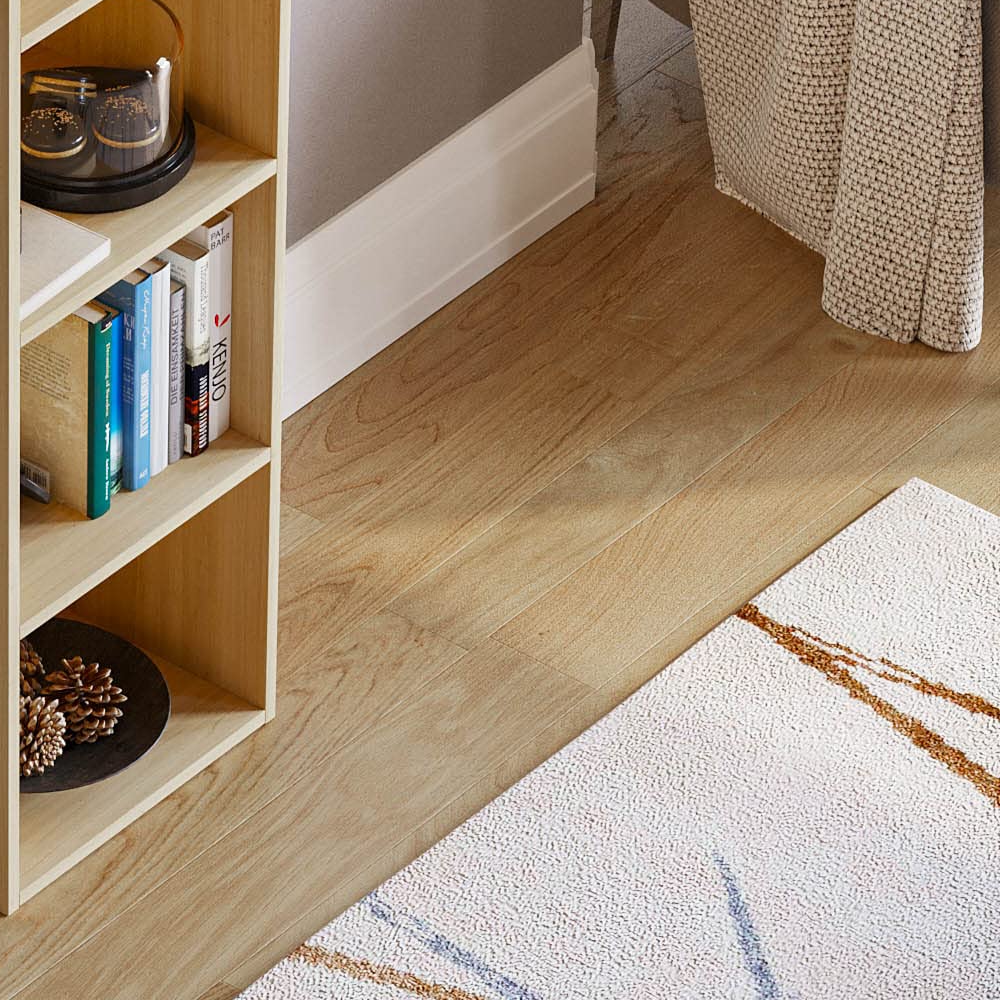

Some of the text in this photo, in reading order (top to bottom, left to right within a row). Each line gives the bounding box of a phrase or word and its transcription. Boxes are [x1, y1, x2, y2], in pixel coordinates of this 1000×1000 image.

[210, 227, 225, 241] PAT
[210, 232, 230, 251] BARR
[170, 308, 180, 405] DIE EINSAMKEIT
[211, 336, 228, 402] KENJO
